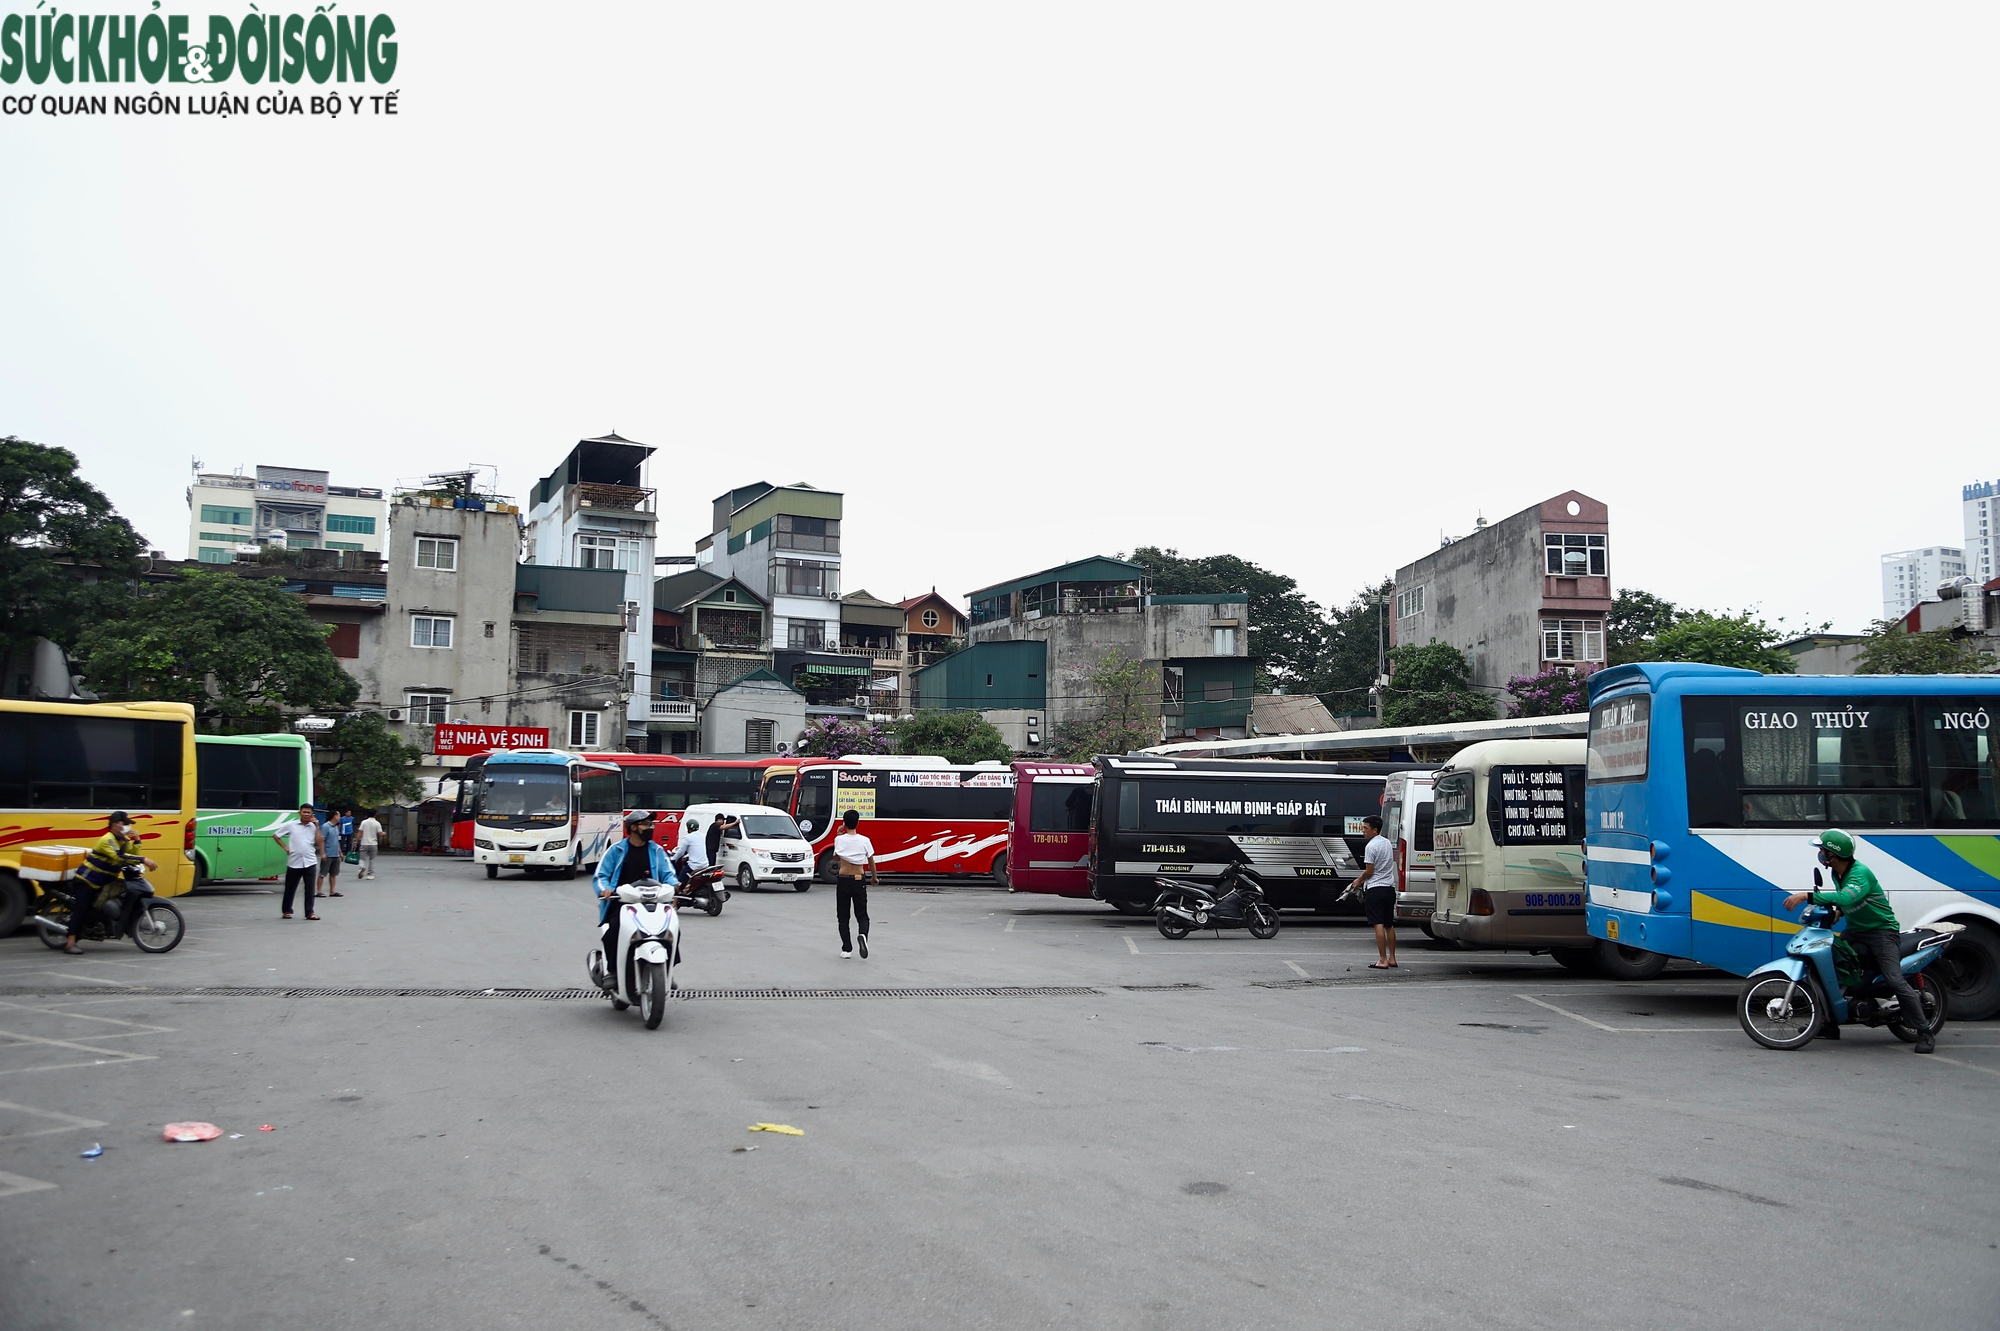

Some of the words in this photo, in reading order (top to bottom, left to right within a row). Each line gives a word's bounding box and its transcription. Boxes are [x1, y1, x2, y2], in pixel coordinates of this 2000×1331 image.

[257, 480, 324, 493] mobifone
[1963, 479, 1993, 501] HÒA
[1620, 699, 1636, 725] PHÁT
[1744, 712, 1798, 730] GIAO
[1811, 705, 1870, 729] THỦY
[1942, 707, 1990, 729] NGÔ
[456, 729, 487, 745] NHÀ
[490, 730, 509, 748] VỆ
[511, 733, 544, 747] SINH
[891, 773, 901, 783] HÀ
[904, 773, 918, 785] NỘI
[1502, 769, 1516, 784] PHỦ
[1517, 770, 1524, 784] LÝ
[1530, 772, 1544, 786] CHỢ
[1155, 797, 1181, 813] THÁI
[1184, 798, 1242, 815] BÌNH-NAM
[1244, 800, 1303, 817] ĐỊNH-GIÁP
[1305, 800, 1327, 816] BÁT
[208, 826, 253, 835] 18B.012.31
[1033, 834, 1068, 843] 17B-014.13
[1141, 844, 1186, 853] 17B-015.18
[1827, 841, 1842, 852] Grab
[1525, 893, 1581, 907] 90B-000.28
